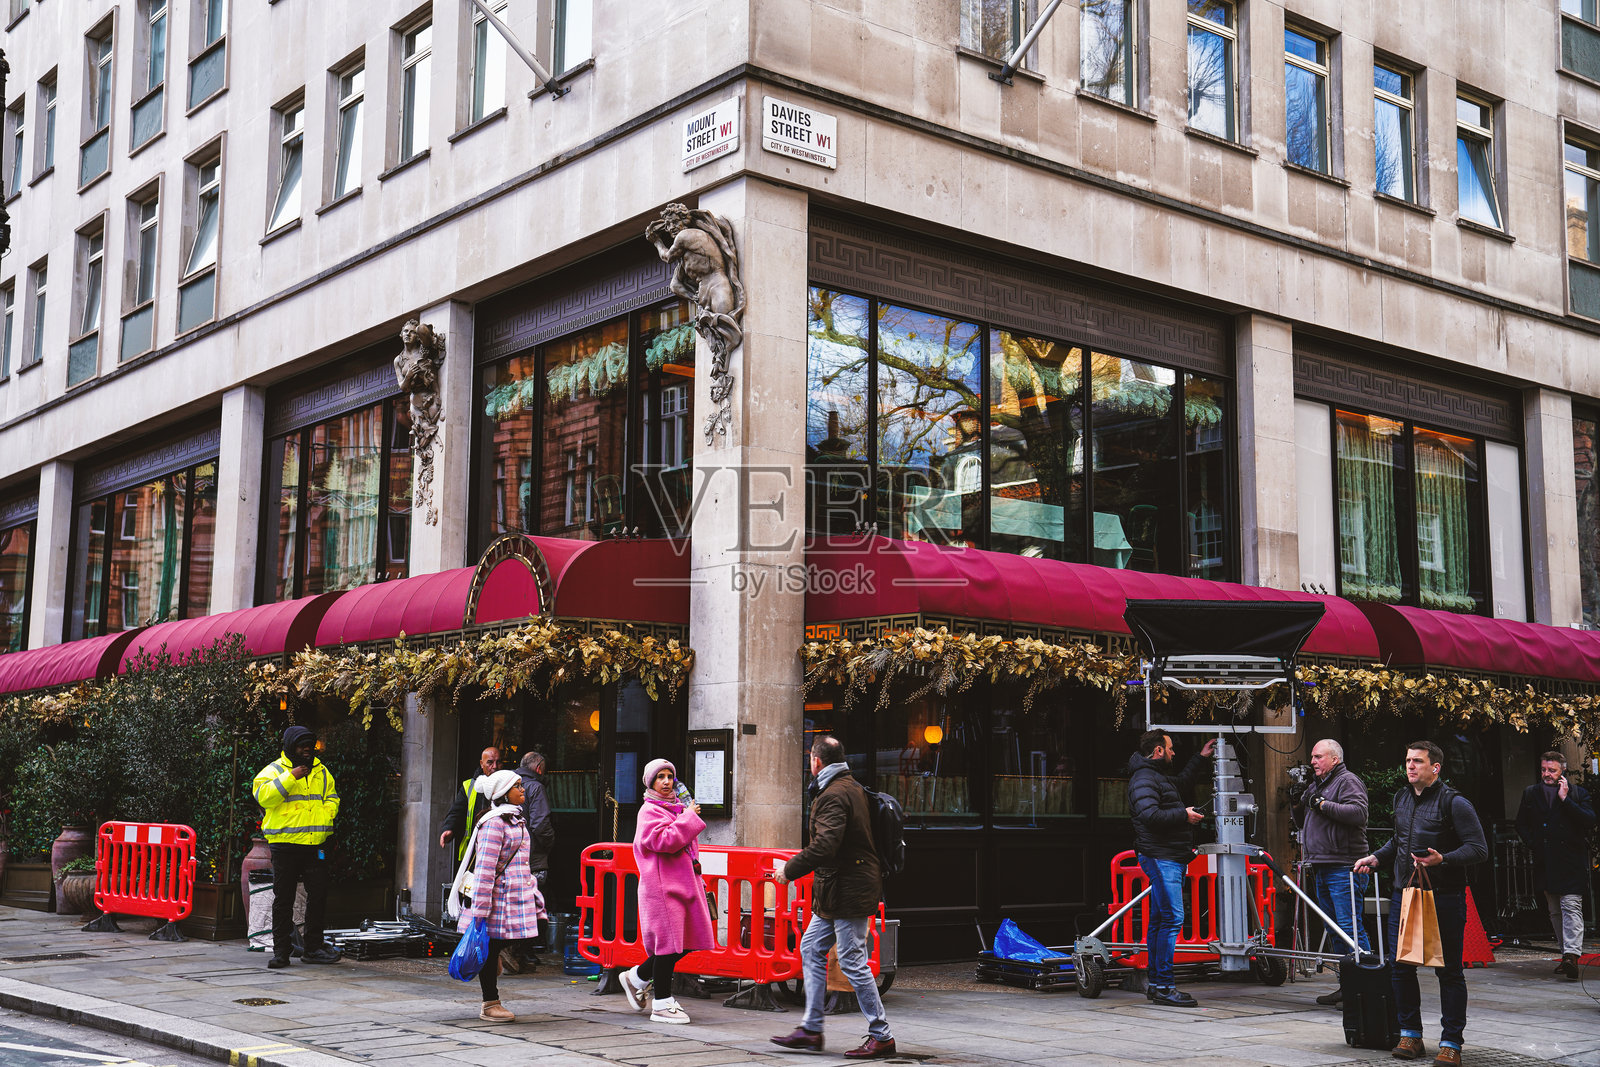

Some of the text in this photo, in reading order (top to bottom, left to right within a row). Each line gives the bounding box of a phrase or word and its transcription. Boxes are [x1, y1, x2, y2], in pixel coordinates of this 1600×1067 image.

[687, 111, 717, 137] MOUNT
[771, 103, 811, 127] DAVIES
[686, 121, 732, 153] STREET W1
[771, 120, 831, 150] STREET W1
[685, 144, 729, 167] CITY OF WESTMINSTER
[770, 141, 827, 164] CITY OF WESTMINSTER
